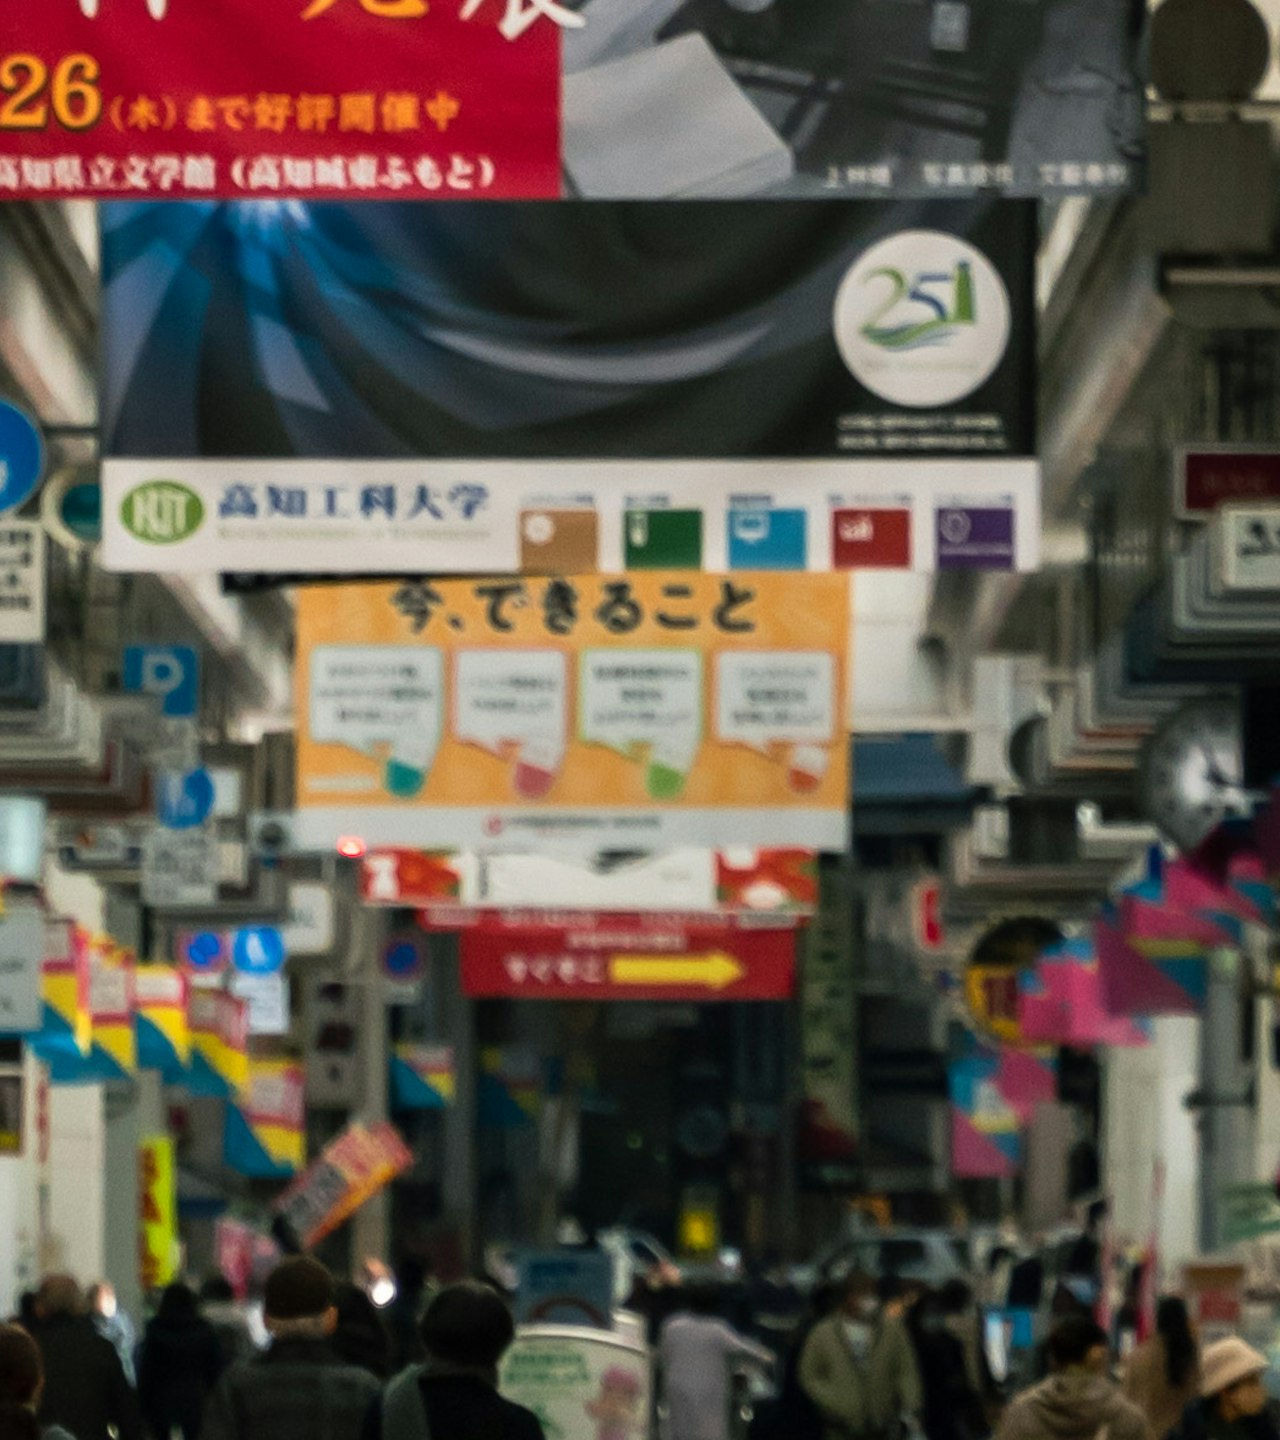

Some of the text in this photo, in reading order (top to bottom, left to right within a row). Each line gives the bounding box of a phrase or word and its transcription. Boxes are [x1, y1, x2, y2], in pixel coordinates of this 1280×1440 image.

[220, 484, 489, 520] 高知工科大学
[389, 577, 756, 635] 今、できること
